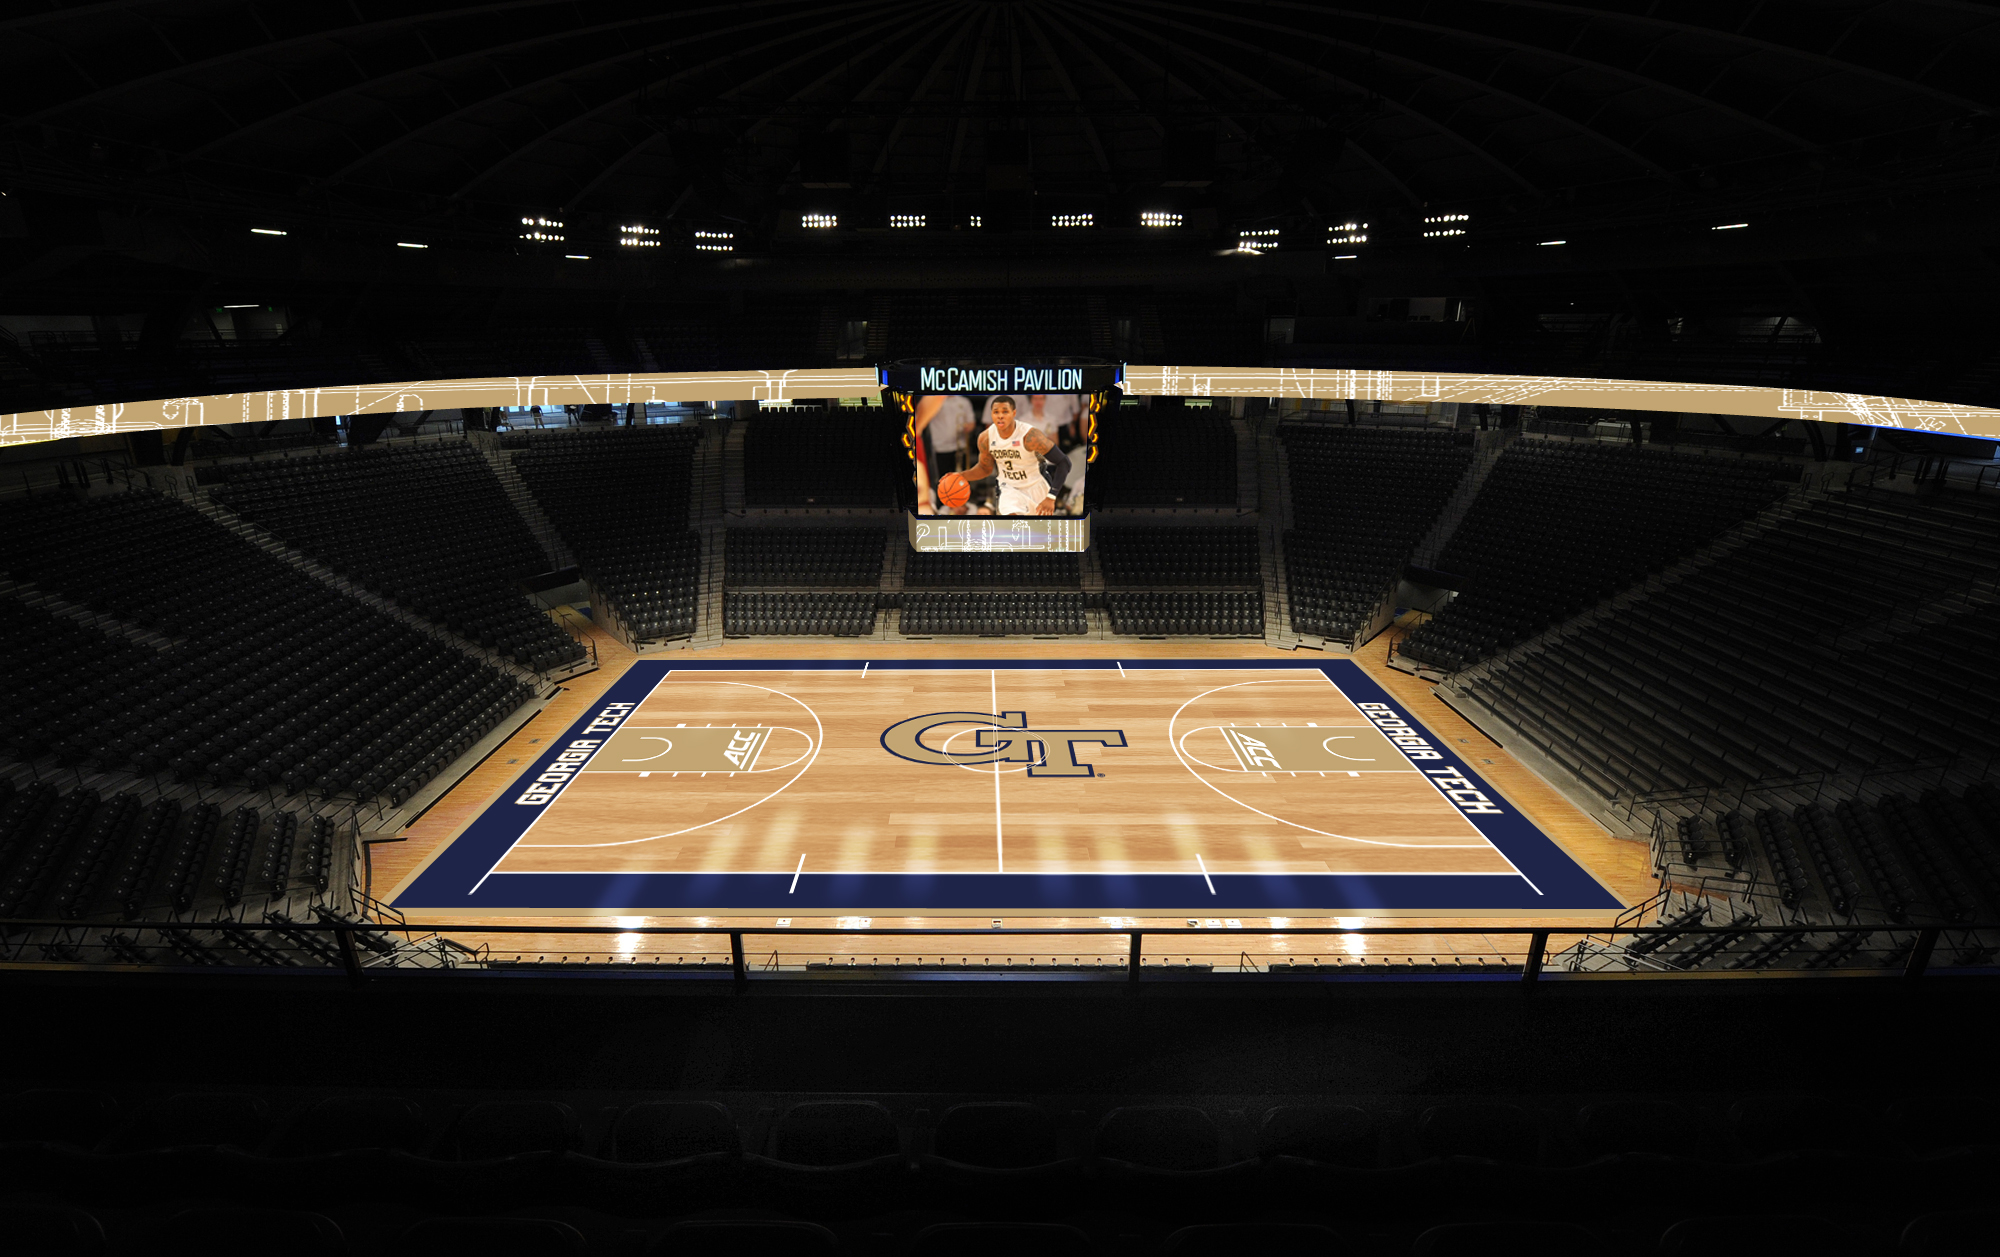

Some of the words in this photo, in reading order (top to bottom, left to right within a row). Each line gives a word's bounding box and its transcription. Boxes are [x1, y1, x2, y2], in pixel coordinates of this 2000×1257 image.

[1002, 469, 1027, 480] TECH
[1004, 460, 1013, 471] 3
[514, 739, 602, 805] GEORGIA
[581, 702, 636, 734] TECH
[723, 730, 757, 766] ACC
[1237, 732, 1282, 770] ACC
[1357, 702, 1443, 760] GEORGIA
[1424, 766, 1504, 814] TECH
